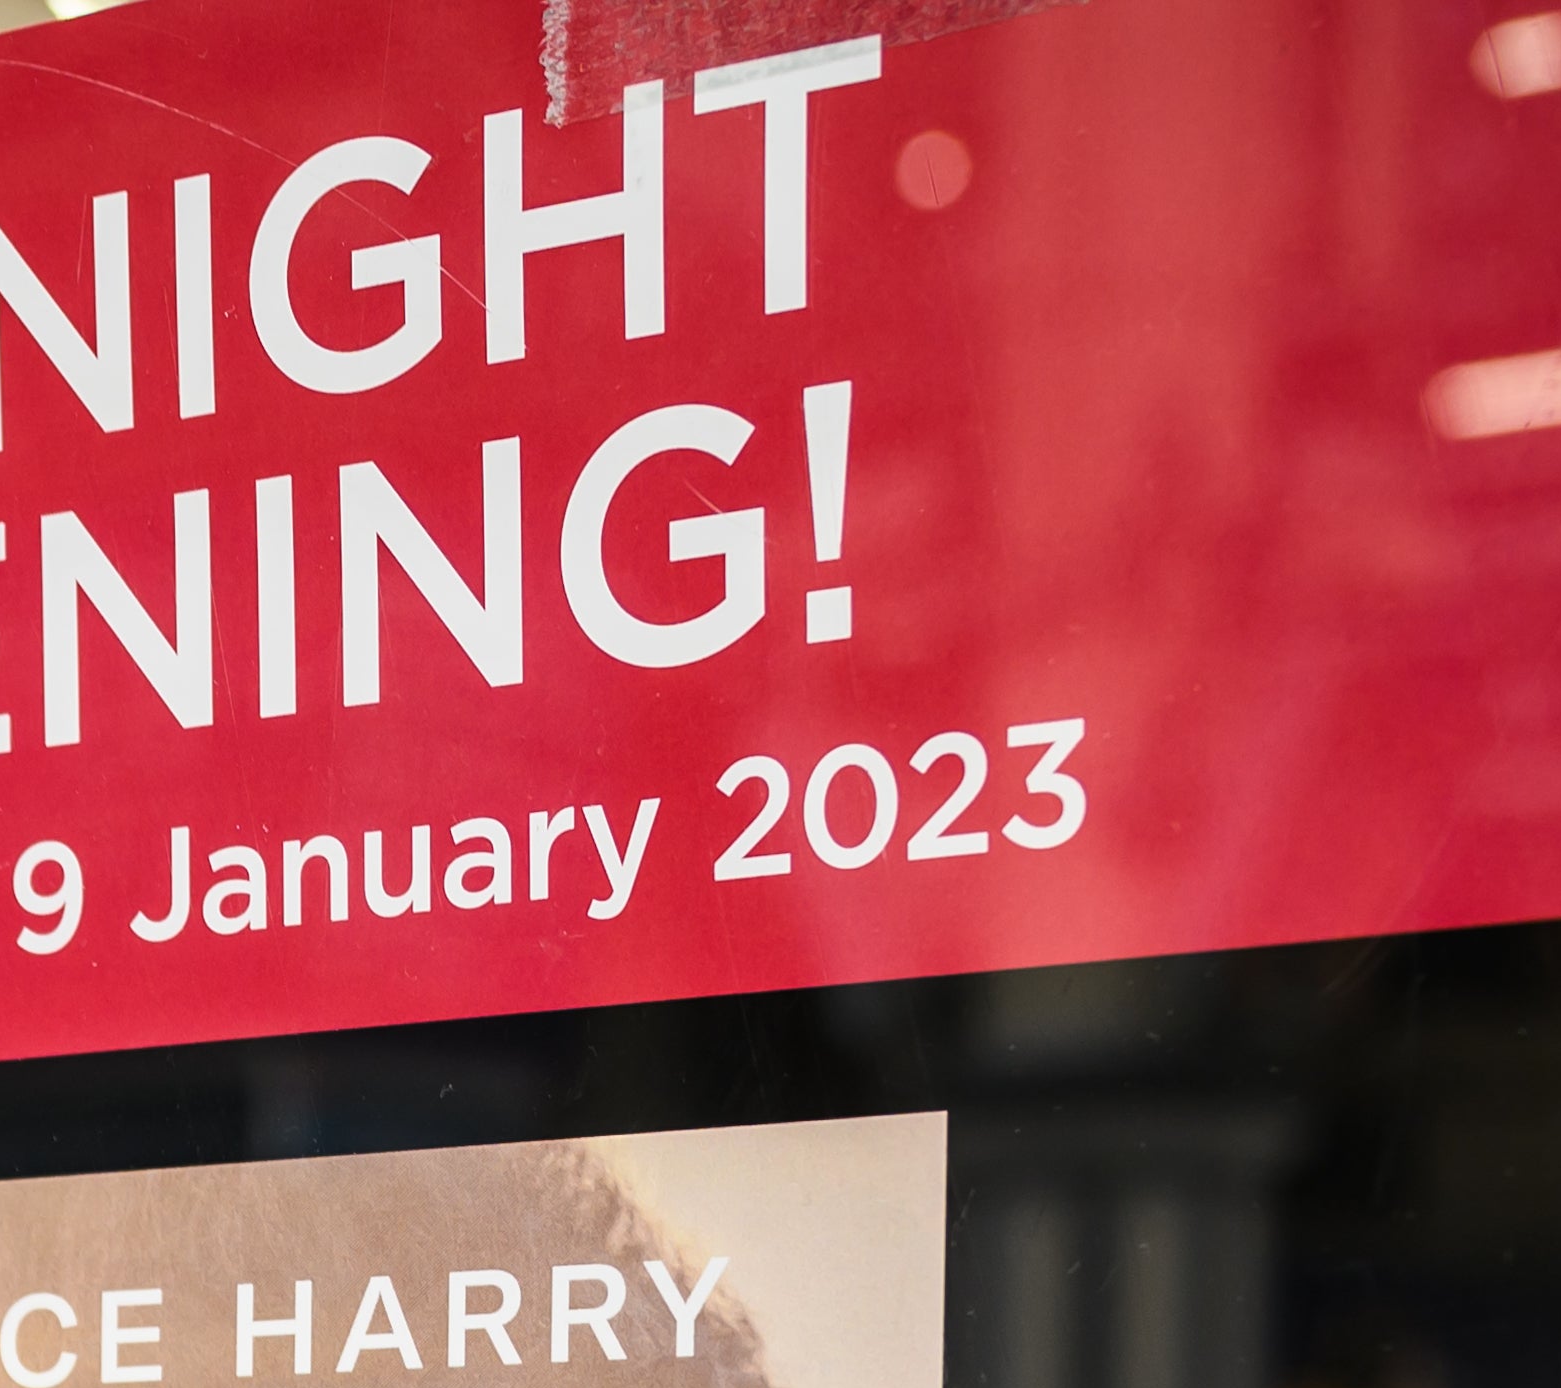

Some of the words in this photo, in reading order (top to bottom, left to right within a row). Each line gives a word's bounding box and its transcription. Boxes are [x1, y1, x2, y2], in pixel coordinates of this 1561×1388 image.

[12, 839, 85, 956] 9
[130, 798, 661, 943] January
[713, 717, 1088, 882] 2023
[236, 1255, 731, 1378] HARRY
